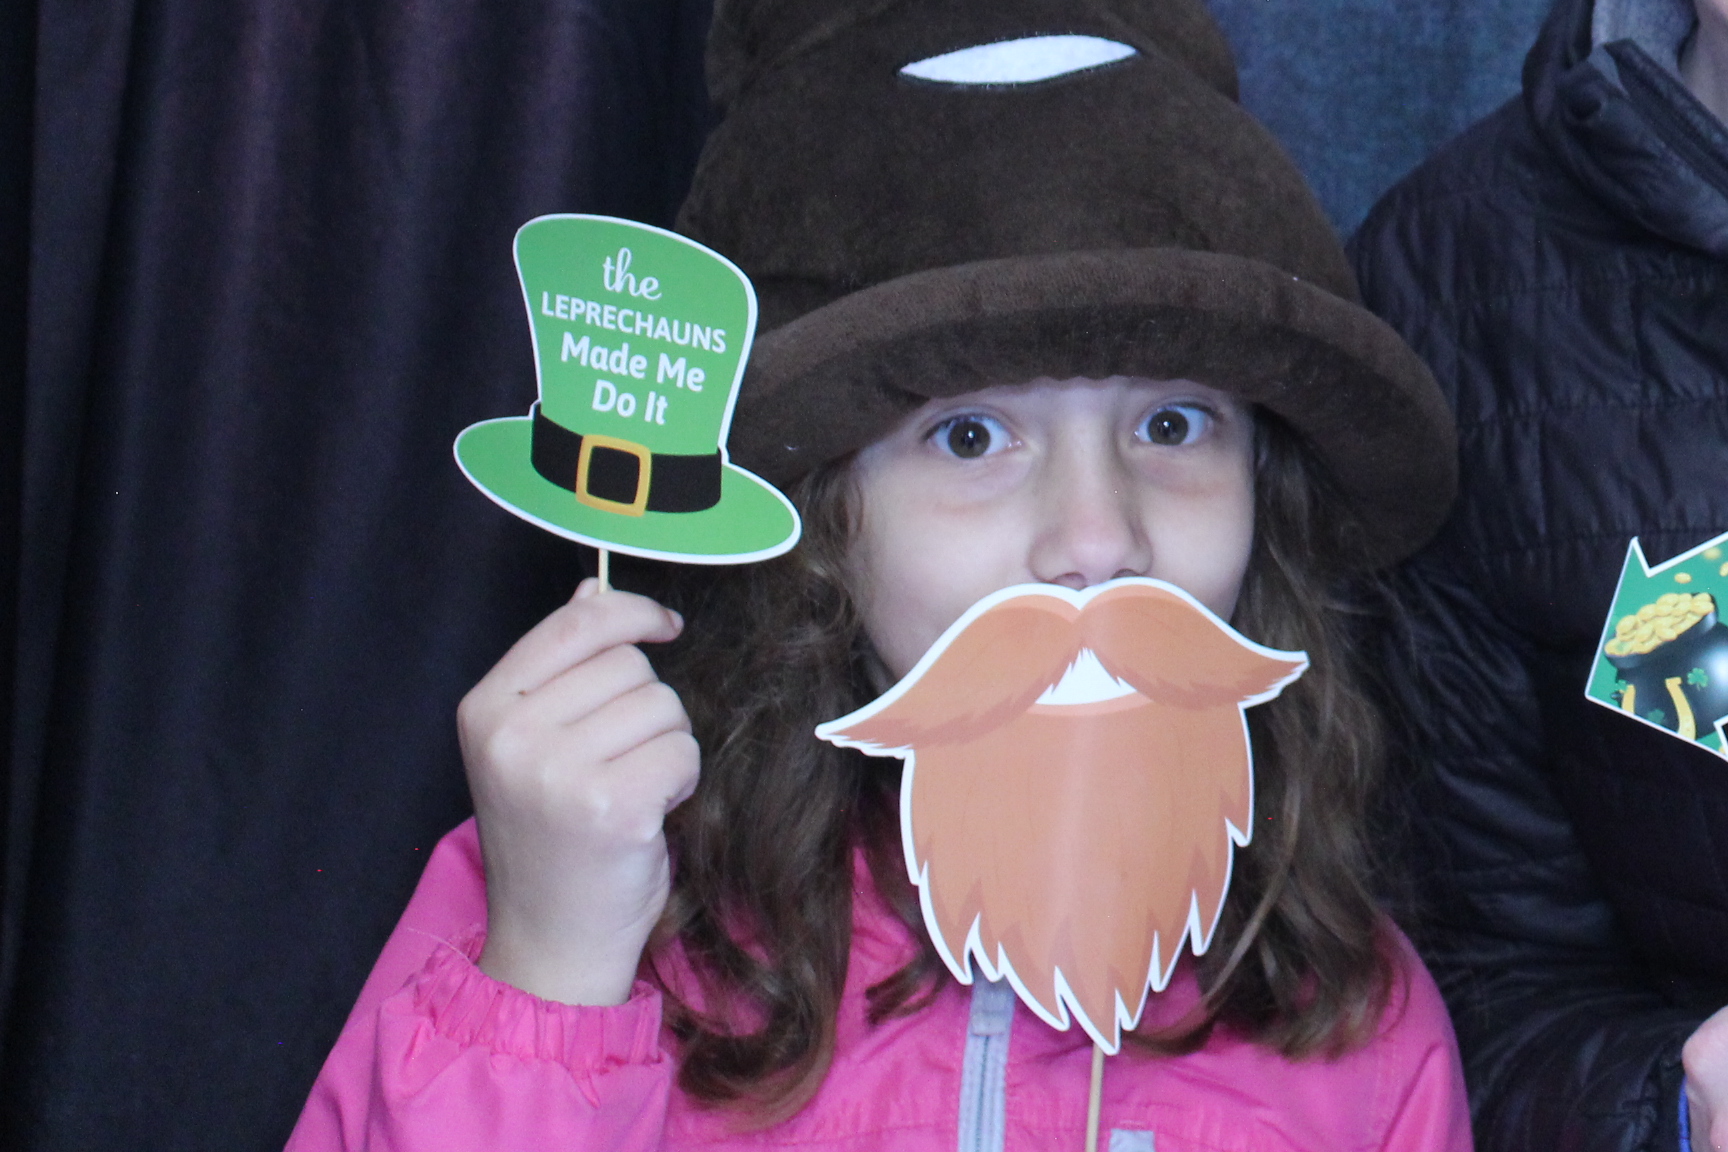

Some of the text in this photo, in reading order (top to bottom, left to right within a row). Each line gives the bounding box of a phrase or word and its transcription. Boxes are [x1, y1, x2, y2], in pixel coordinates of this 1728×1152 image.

[602, 247, 662, 300] the
[541, 291, 726, 353] LEPRECHAUNS
[561, 332, 705, 392] Made Me
[592, 380, 668, 425] Do It
